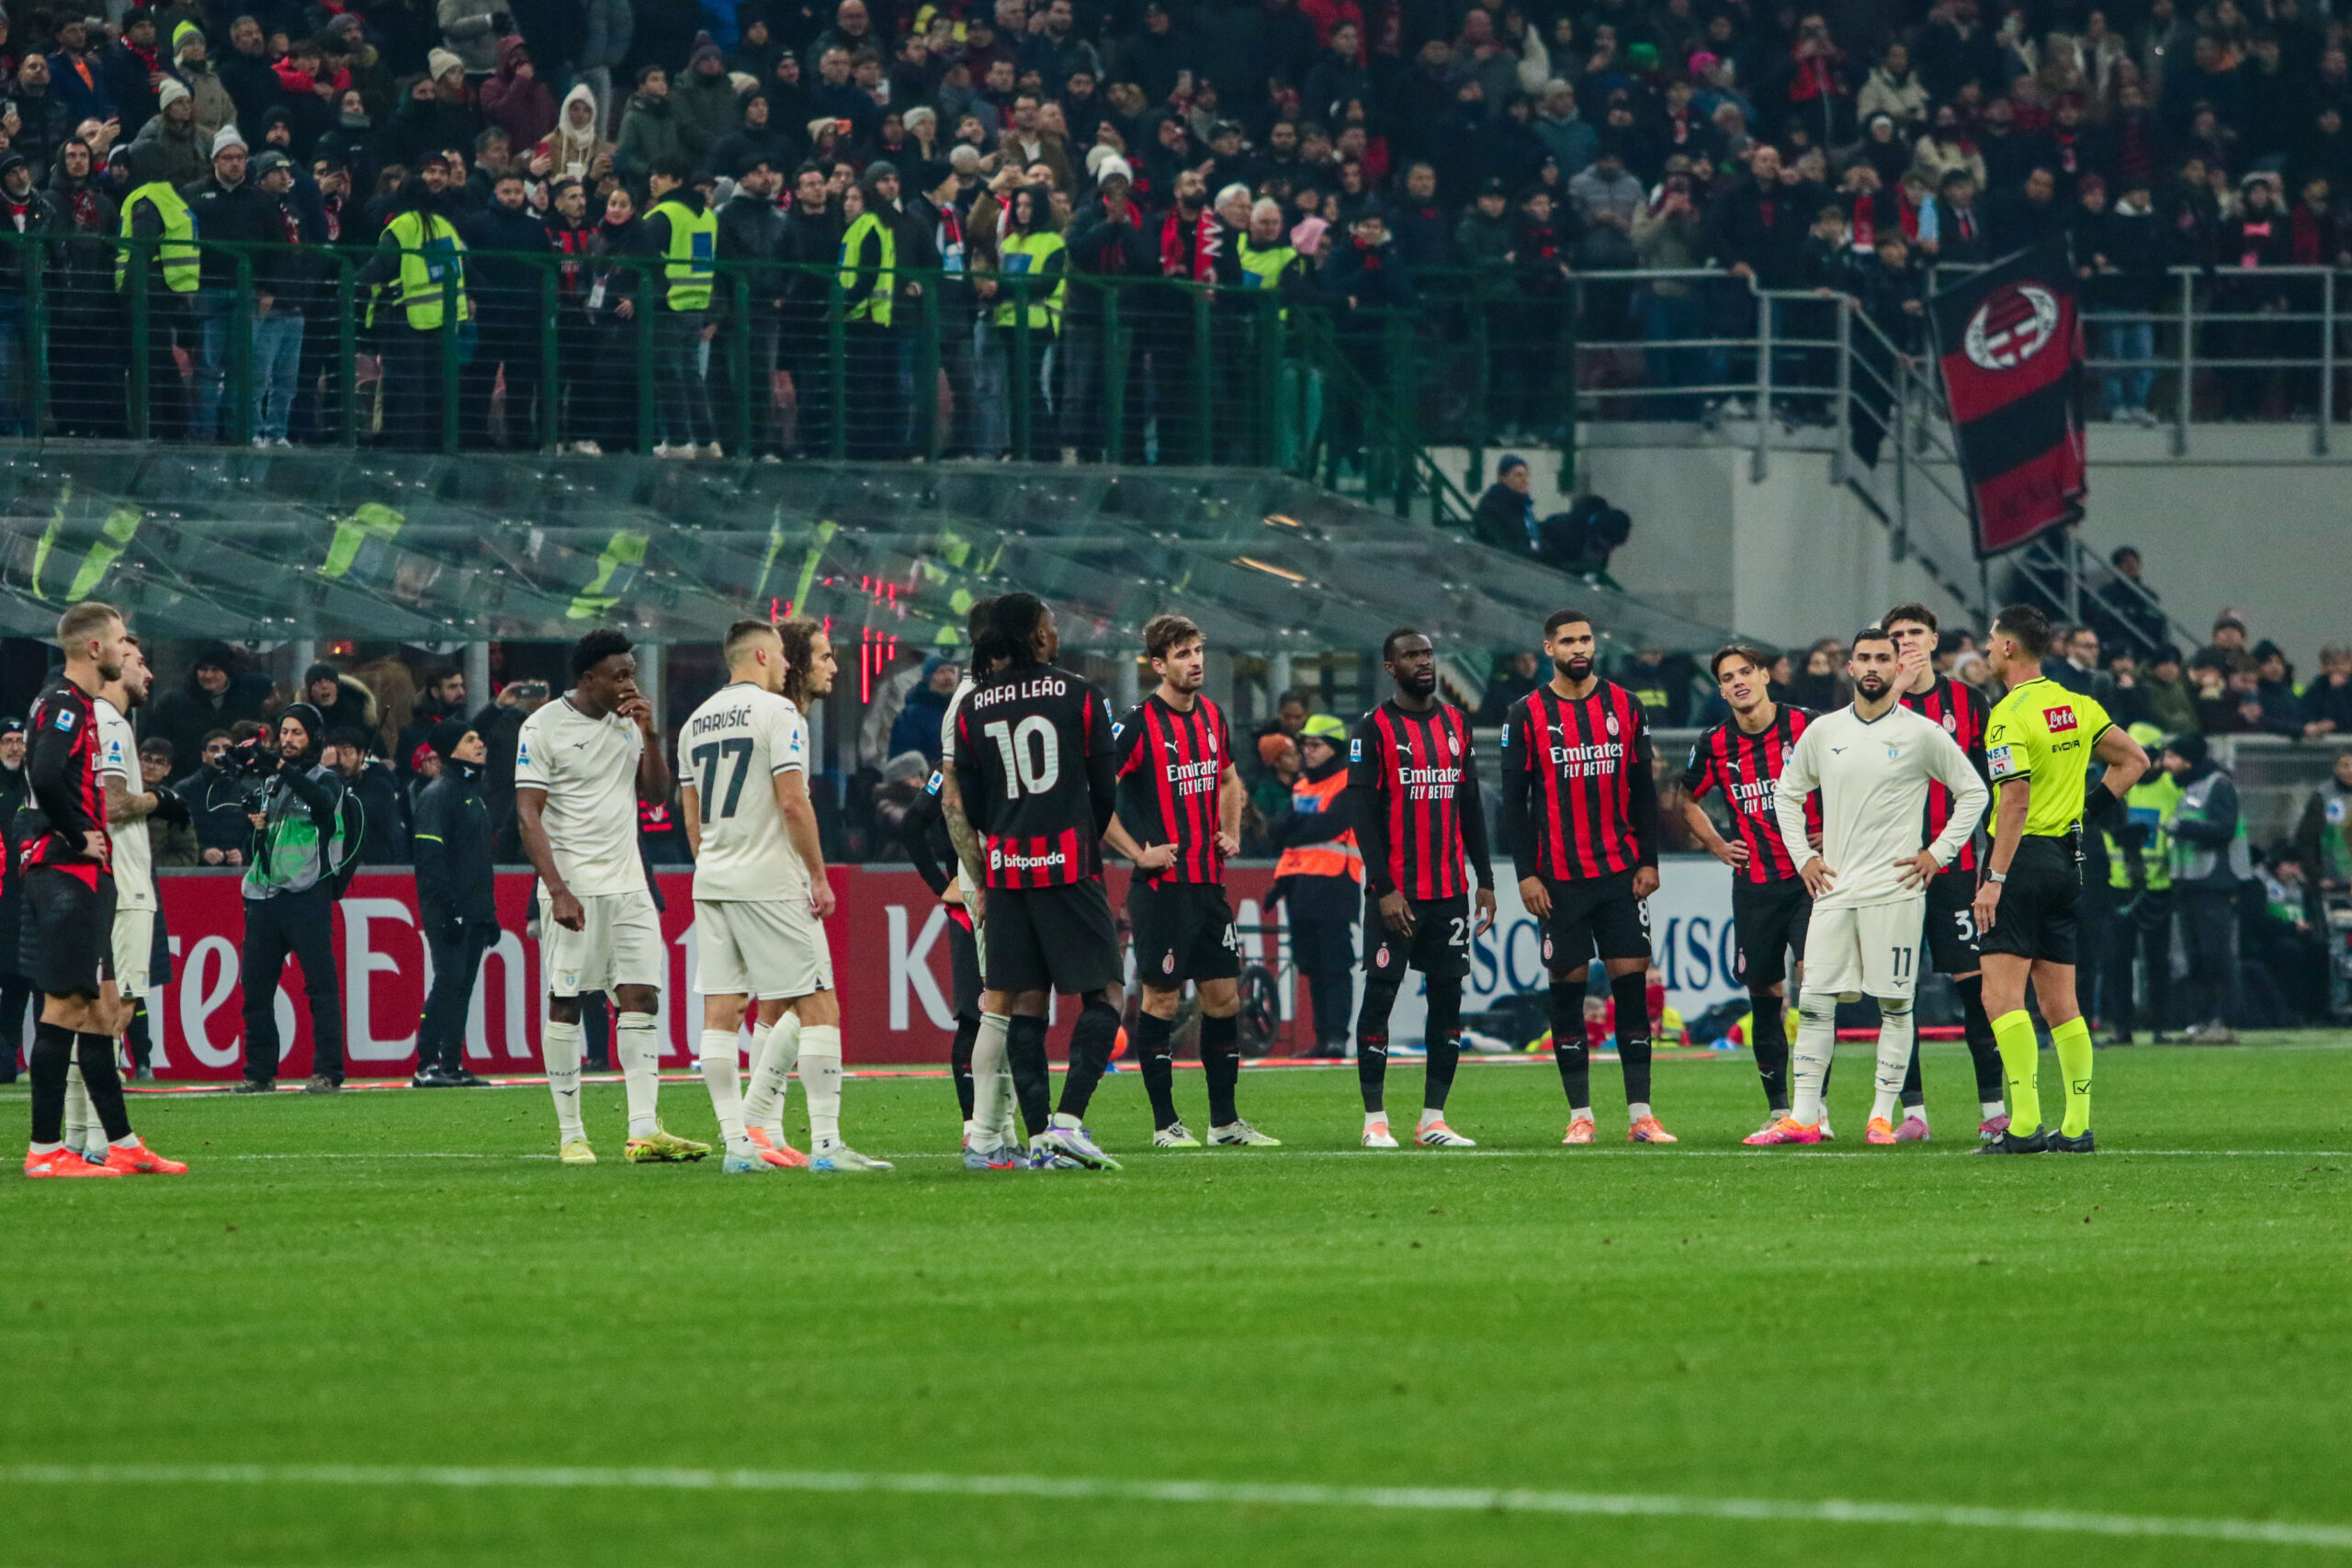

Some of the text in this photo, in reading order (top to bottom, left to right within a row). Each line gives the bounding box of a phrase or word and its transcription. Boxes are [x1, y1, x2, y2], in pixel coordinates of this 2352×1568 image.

[974, 676, 1067, 711] RAFA LEÃO
[2049, 709, 2076, 729] Lete
[984, 715, 1059, 800] 10
[1549, 741, 1623, 764] Emirates
[691, 737, 754, 825] 77
[1397, 765, 1462, 784] Emirate
[1564, 763, 1580, 779] FLY
[1179, 781, 1194, 796] FLY
[1409, 785, 1426, 800] FLY
[1729, 778, 1780, 800] Emira
[1744, 799, 1758, 815] FLY
[1003, 851, 1066, 871] bitpanda
[1954, 909, 1976, 942] 3
[1891, 946, 1912, 977] 11
